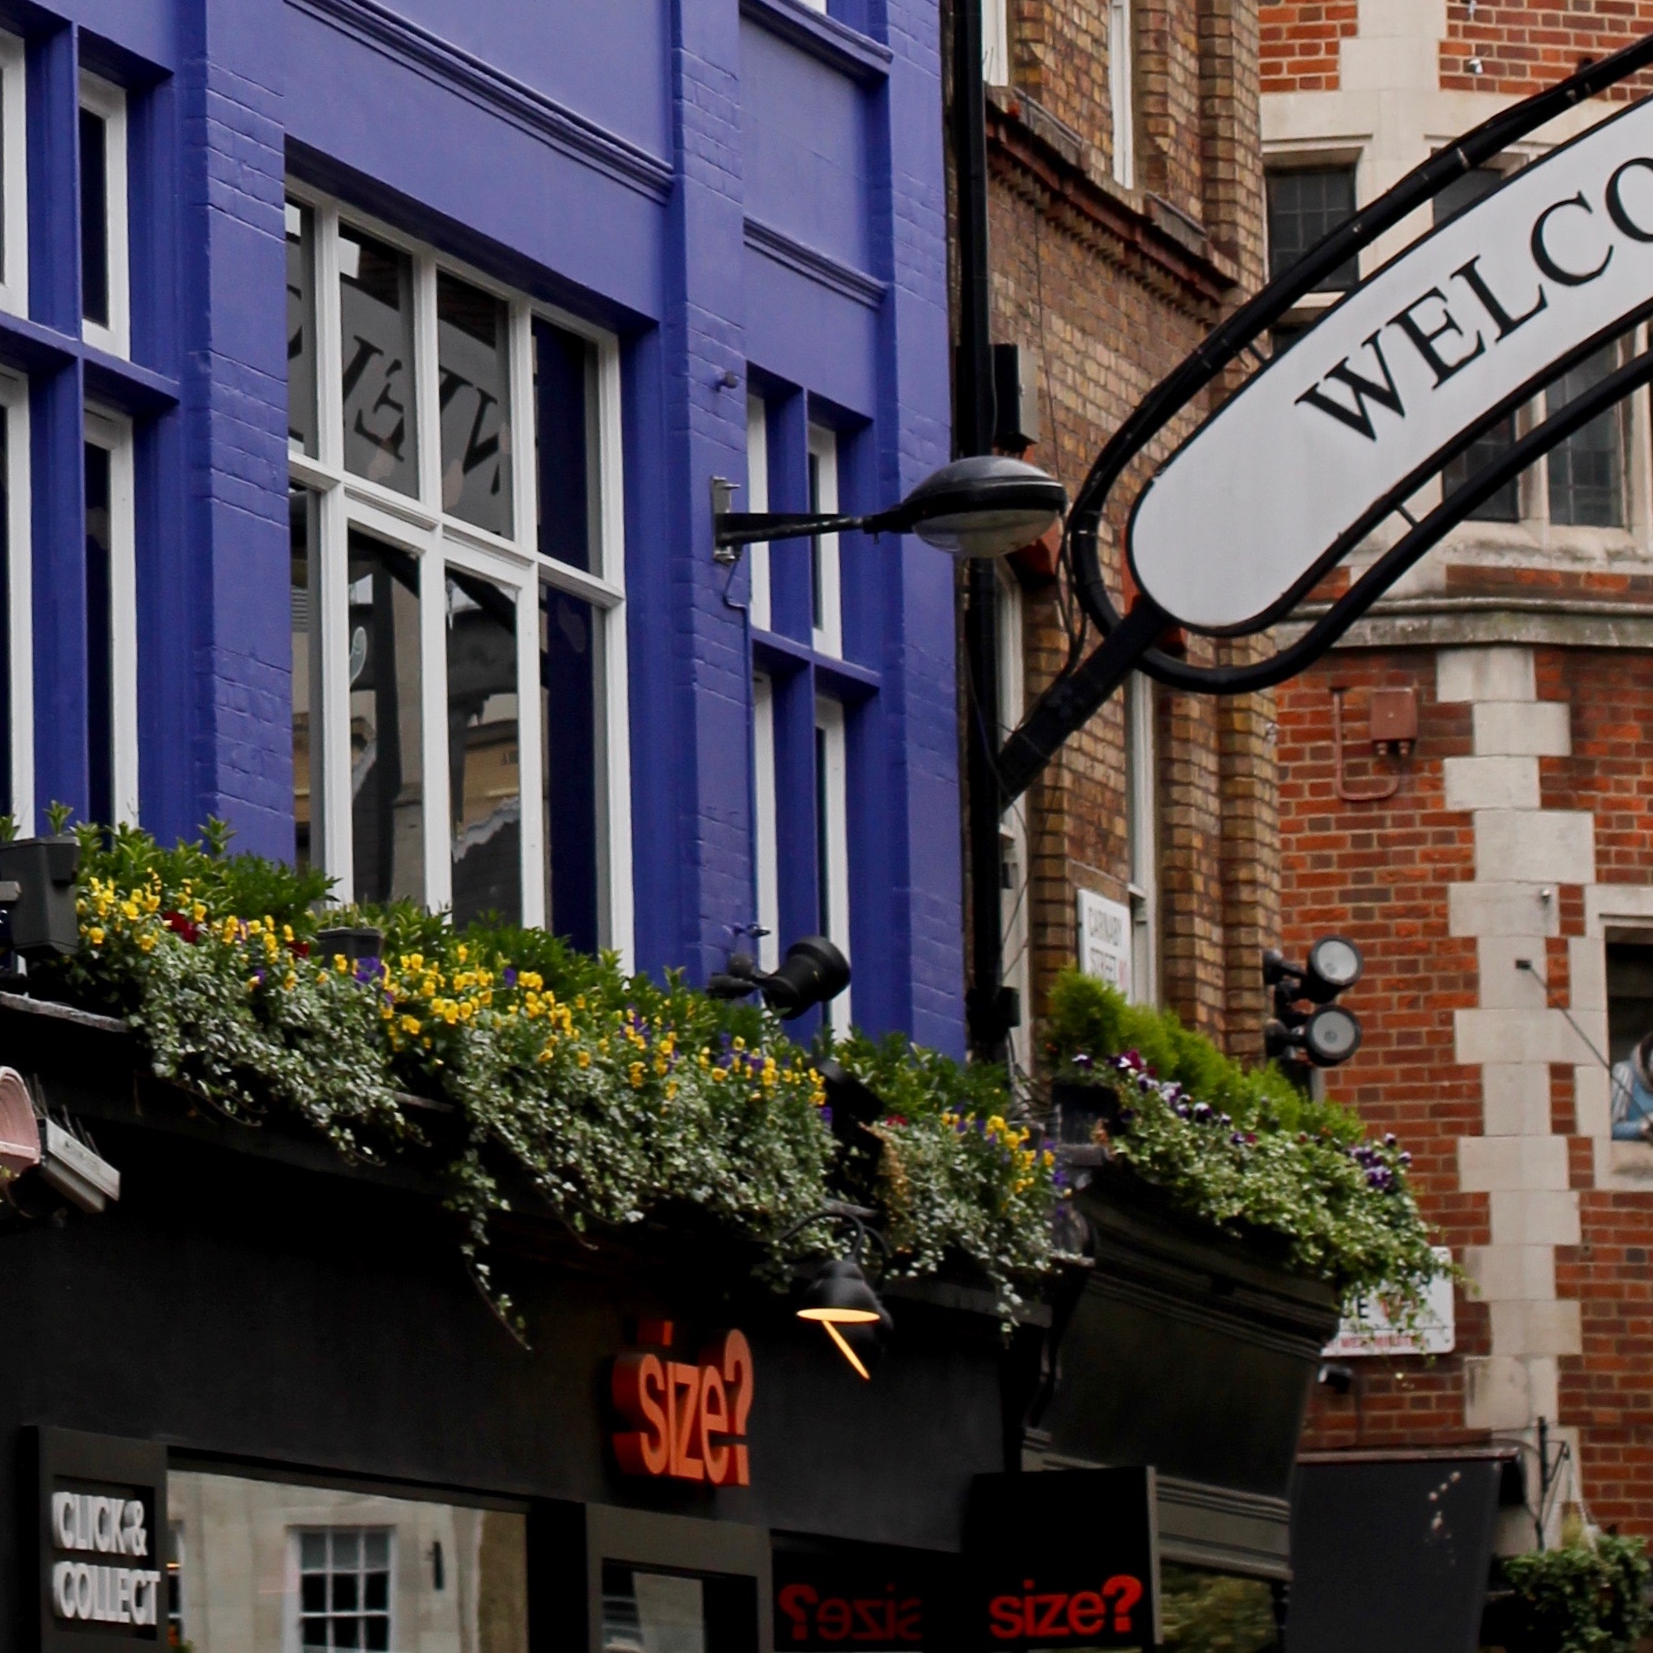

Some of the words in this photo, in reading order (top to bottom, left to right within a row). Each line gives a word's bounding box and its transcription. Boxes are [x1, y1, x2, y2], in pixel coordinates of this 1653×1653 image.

[612, 1320, 754, 1486] size?
[51, 1491, 126, 1554] CLICK
[123, 1500, 147, 1556] &
[52, 1561, 161, 1625] COLLECT
[988, 1574, 1143, 1639] size?
